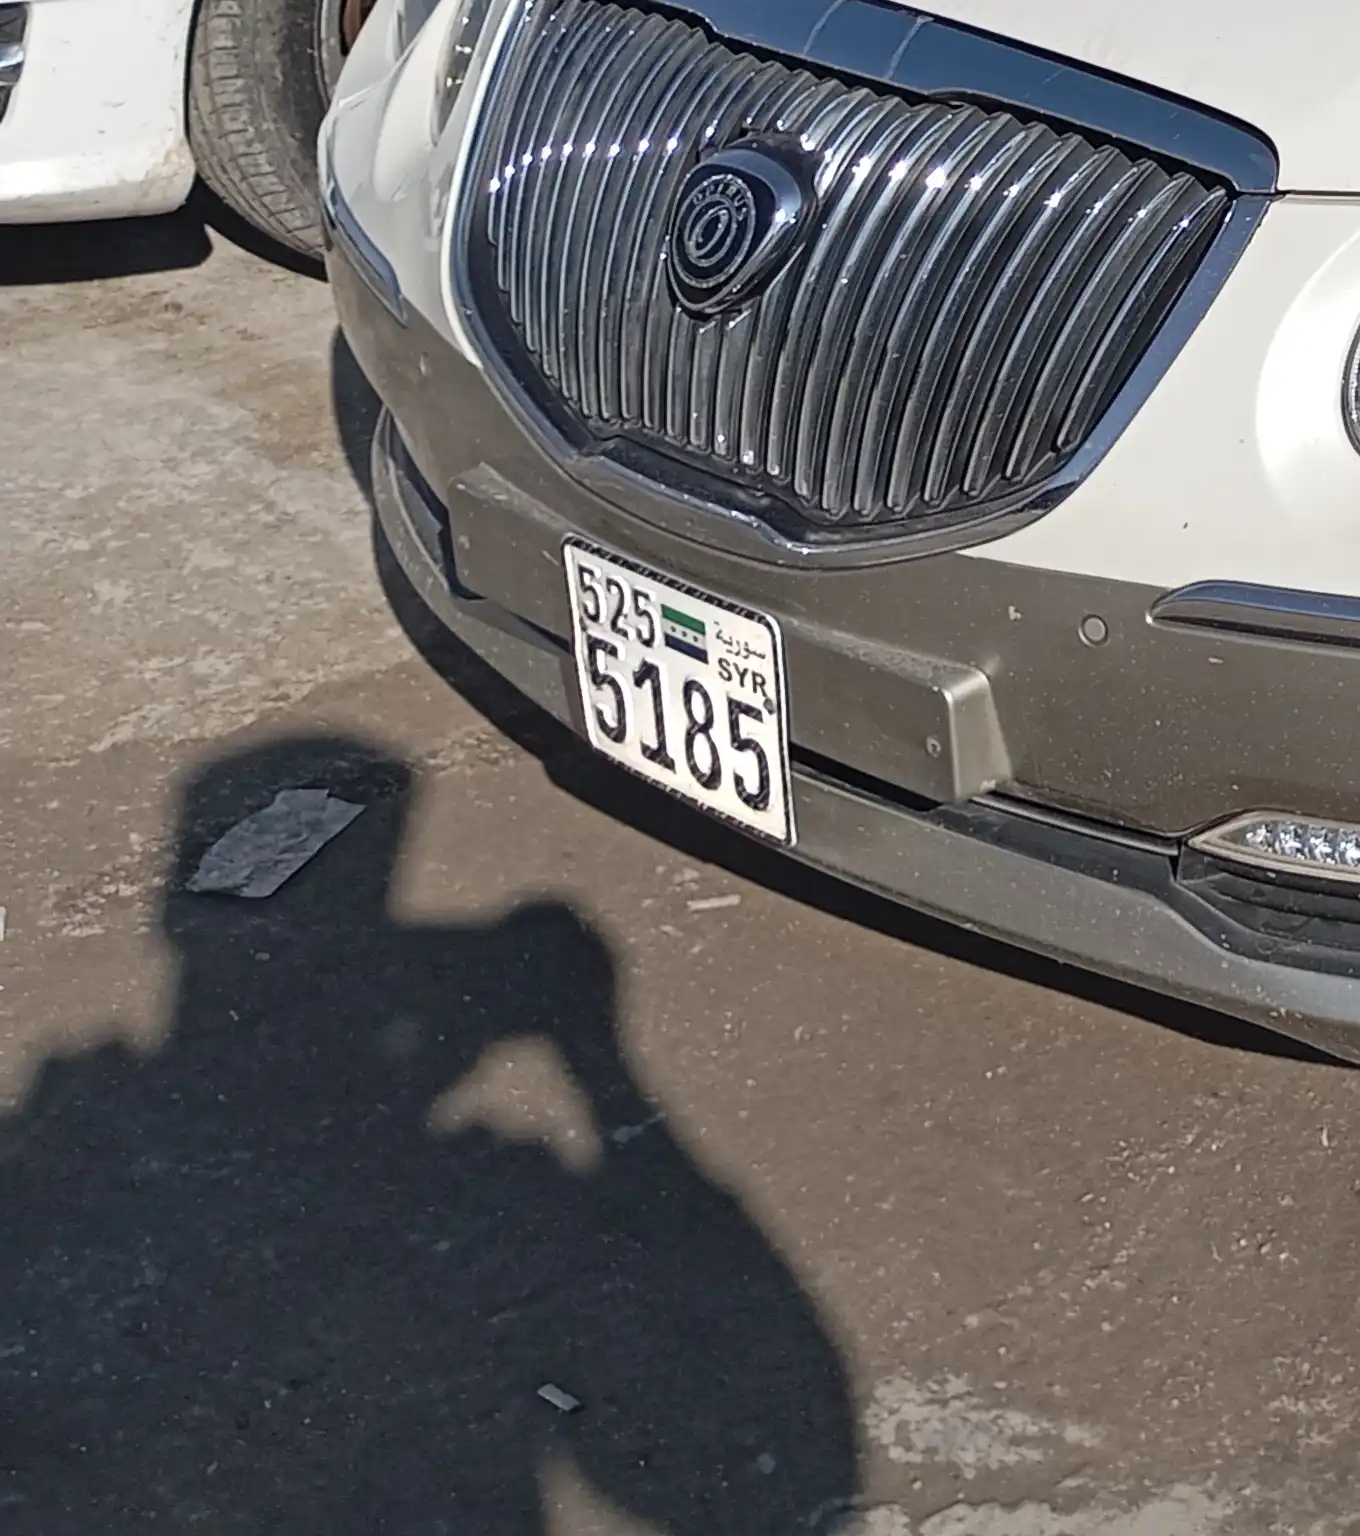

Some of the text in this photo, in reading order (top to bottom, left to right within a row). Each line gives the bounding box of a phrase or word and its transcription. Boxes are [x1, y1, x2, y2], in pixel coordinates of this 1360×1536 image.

[578, 565, 656, 648] 525
[718, 658, 768, 697] SYR
[587, 635, 770, 811] 5185
